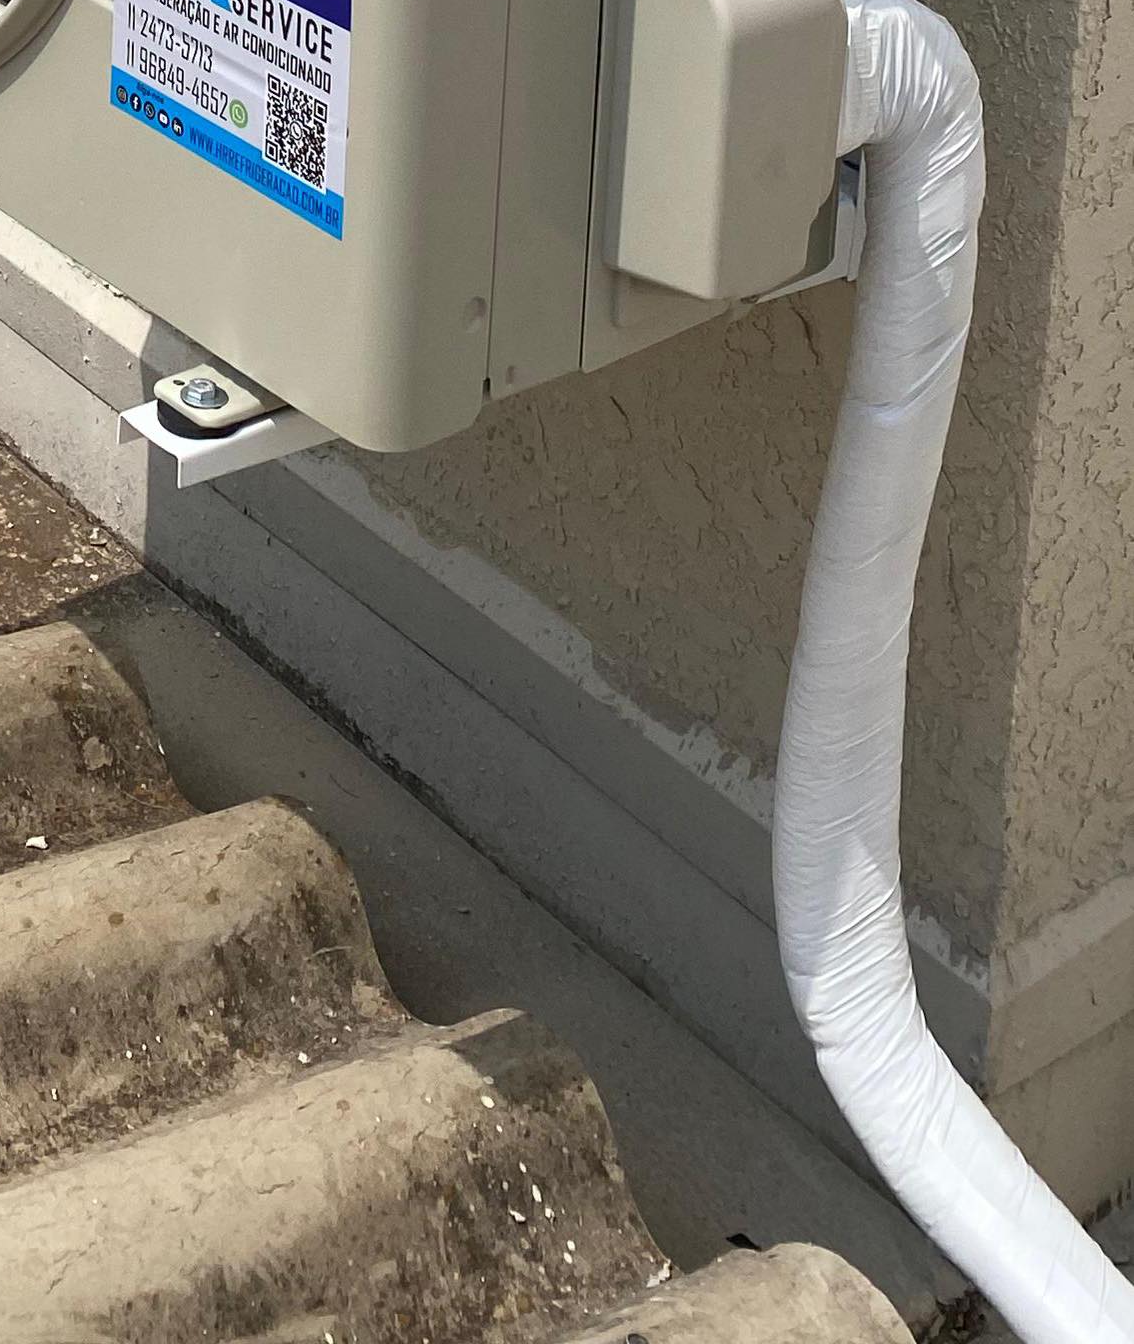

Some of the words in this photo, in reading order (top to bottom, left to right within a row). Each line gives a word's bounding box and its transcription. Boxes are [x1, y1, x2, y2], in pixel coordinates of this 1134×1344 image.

[140, 9, 213, 74] 2473-5713
[213, 13, 220, 35] E
[223, 20, 239, 45] AR
[242, 29, 332, 95] CONDICIONADO
[139, 46, 228, 122] 96849-4652
